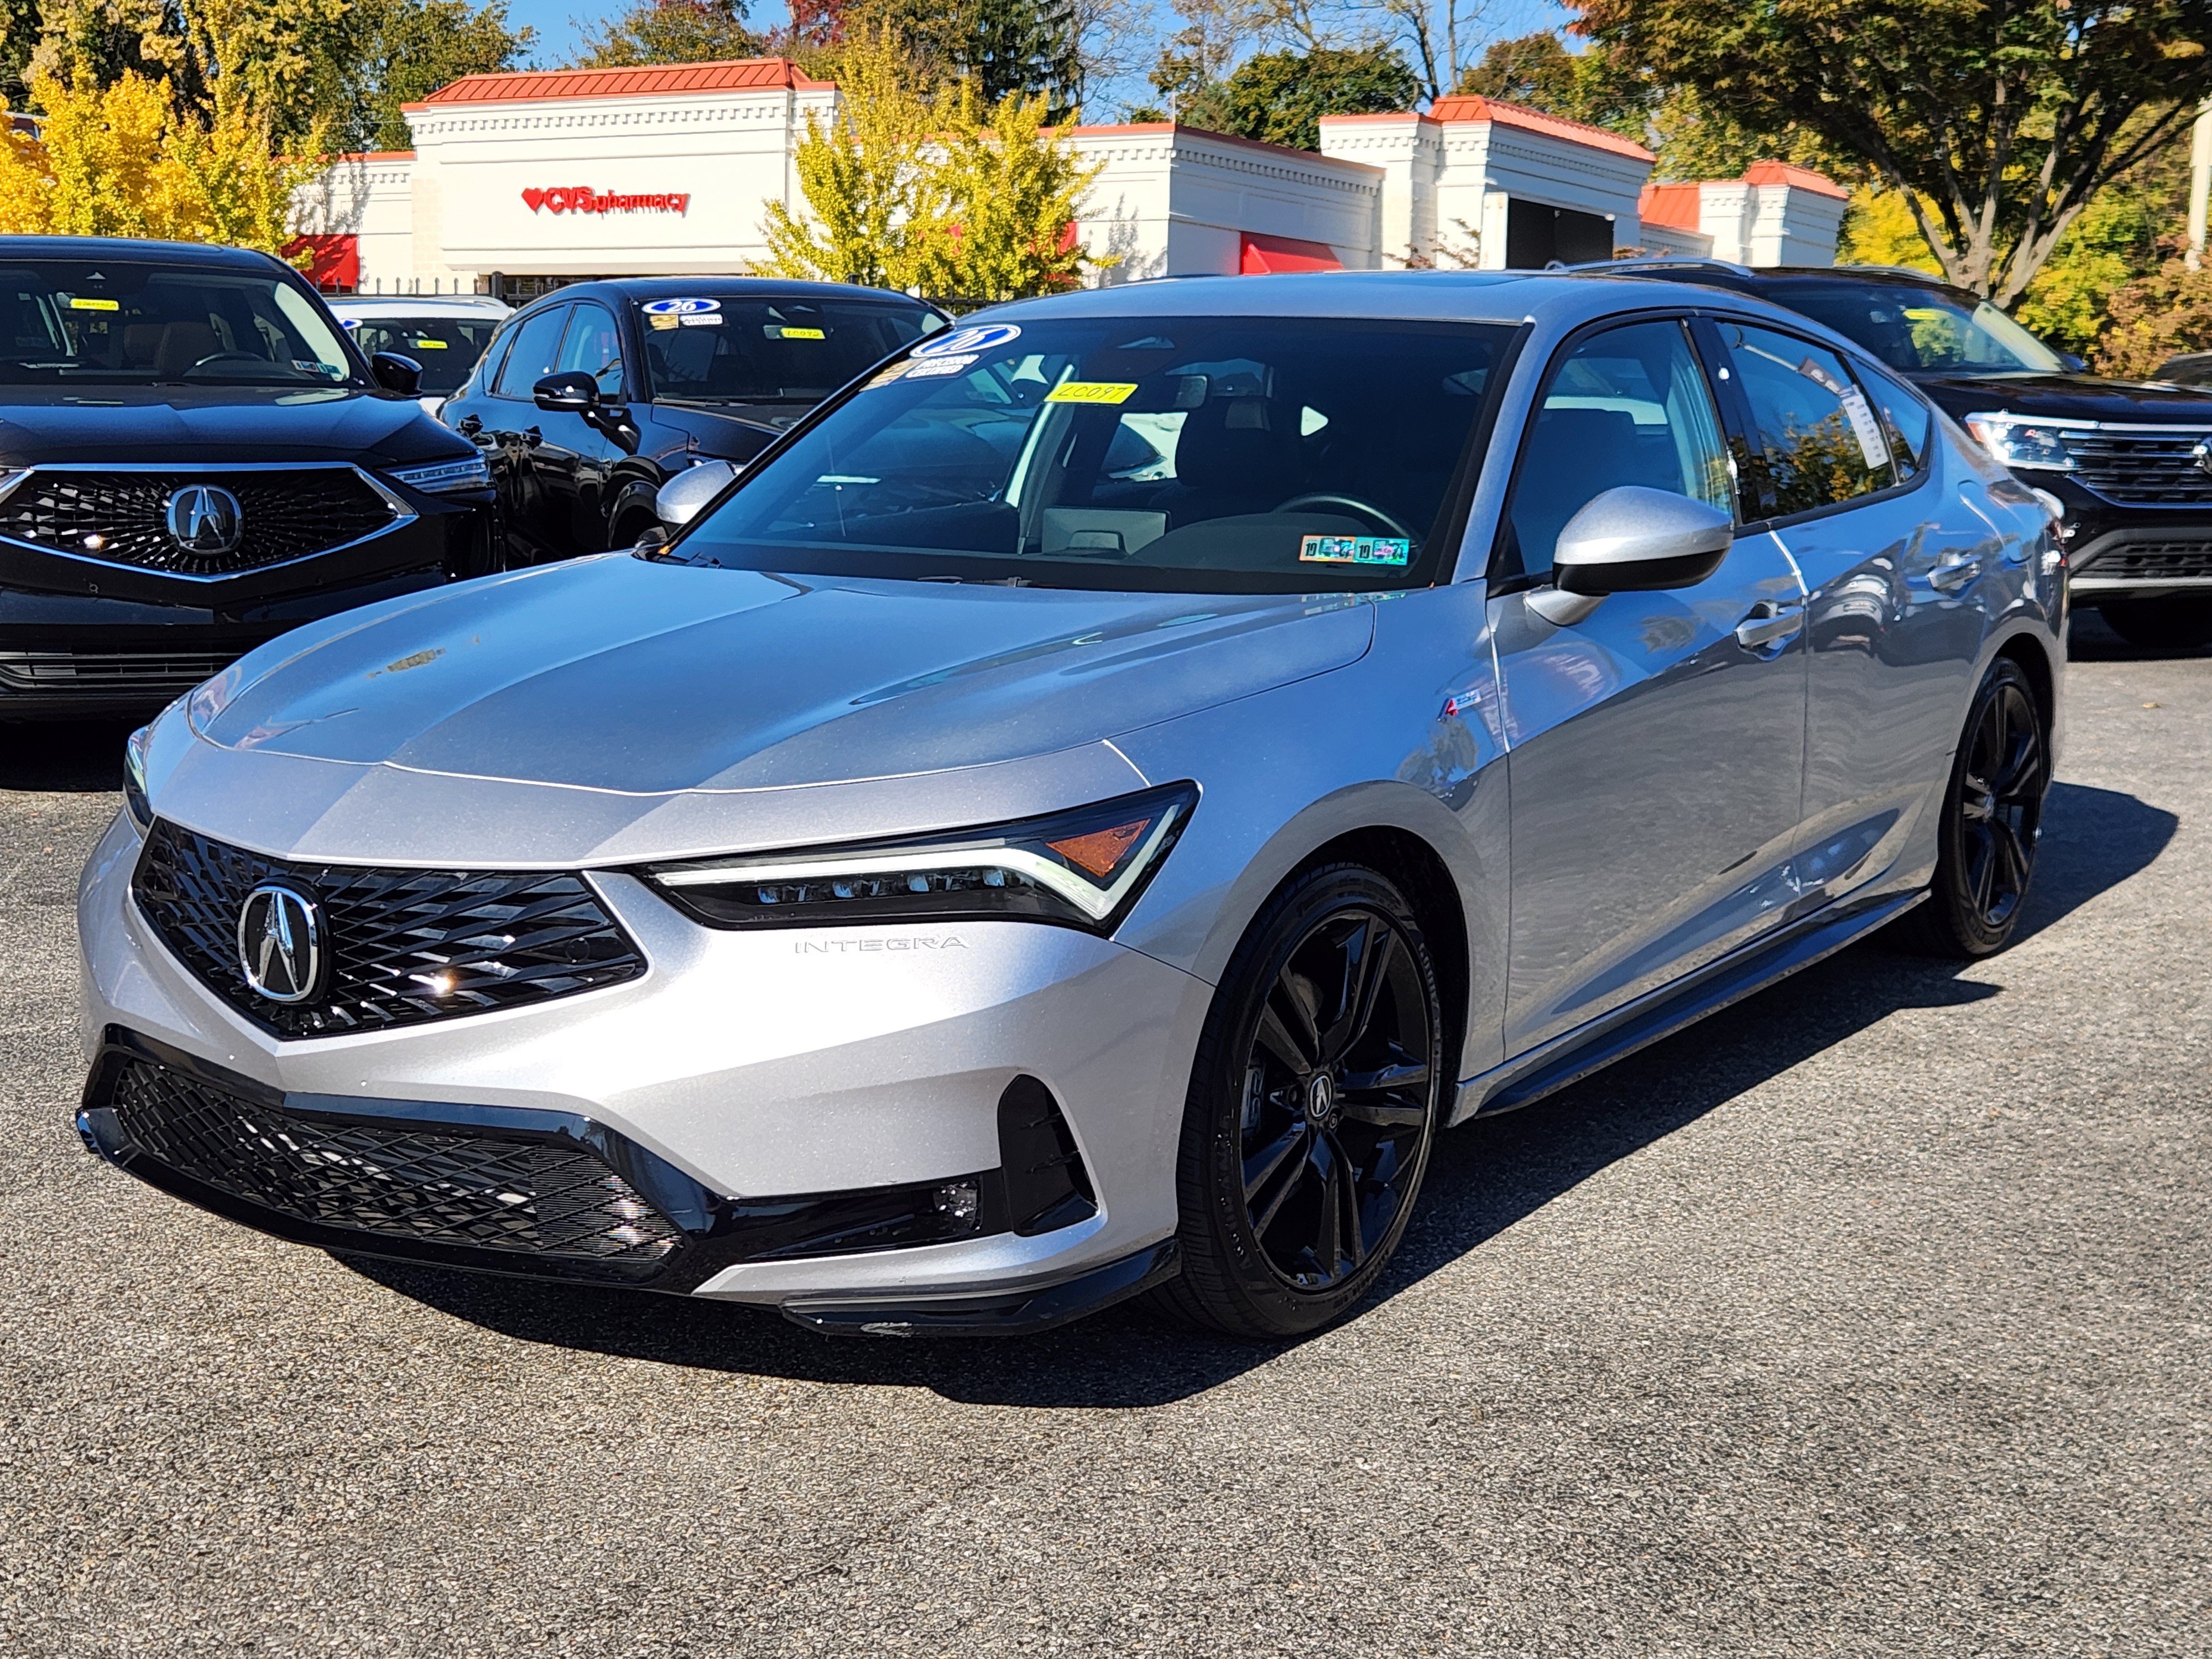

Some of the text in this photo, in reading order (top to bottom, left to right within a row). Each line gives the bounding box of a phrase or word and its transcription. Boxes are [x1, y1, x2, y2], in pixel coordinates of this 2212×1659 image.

[544, 187, 687, 213] CVS pharmacy
[664, 301, 698, 313] 26
[795, 936, 969, 953] INTEGRA
